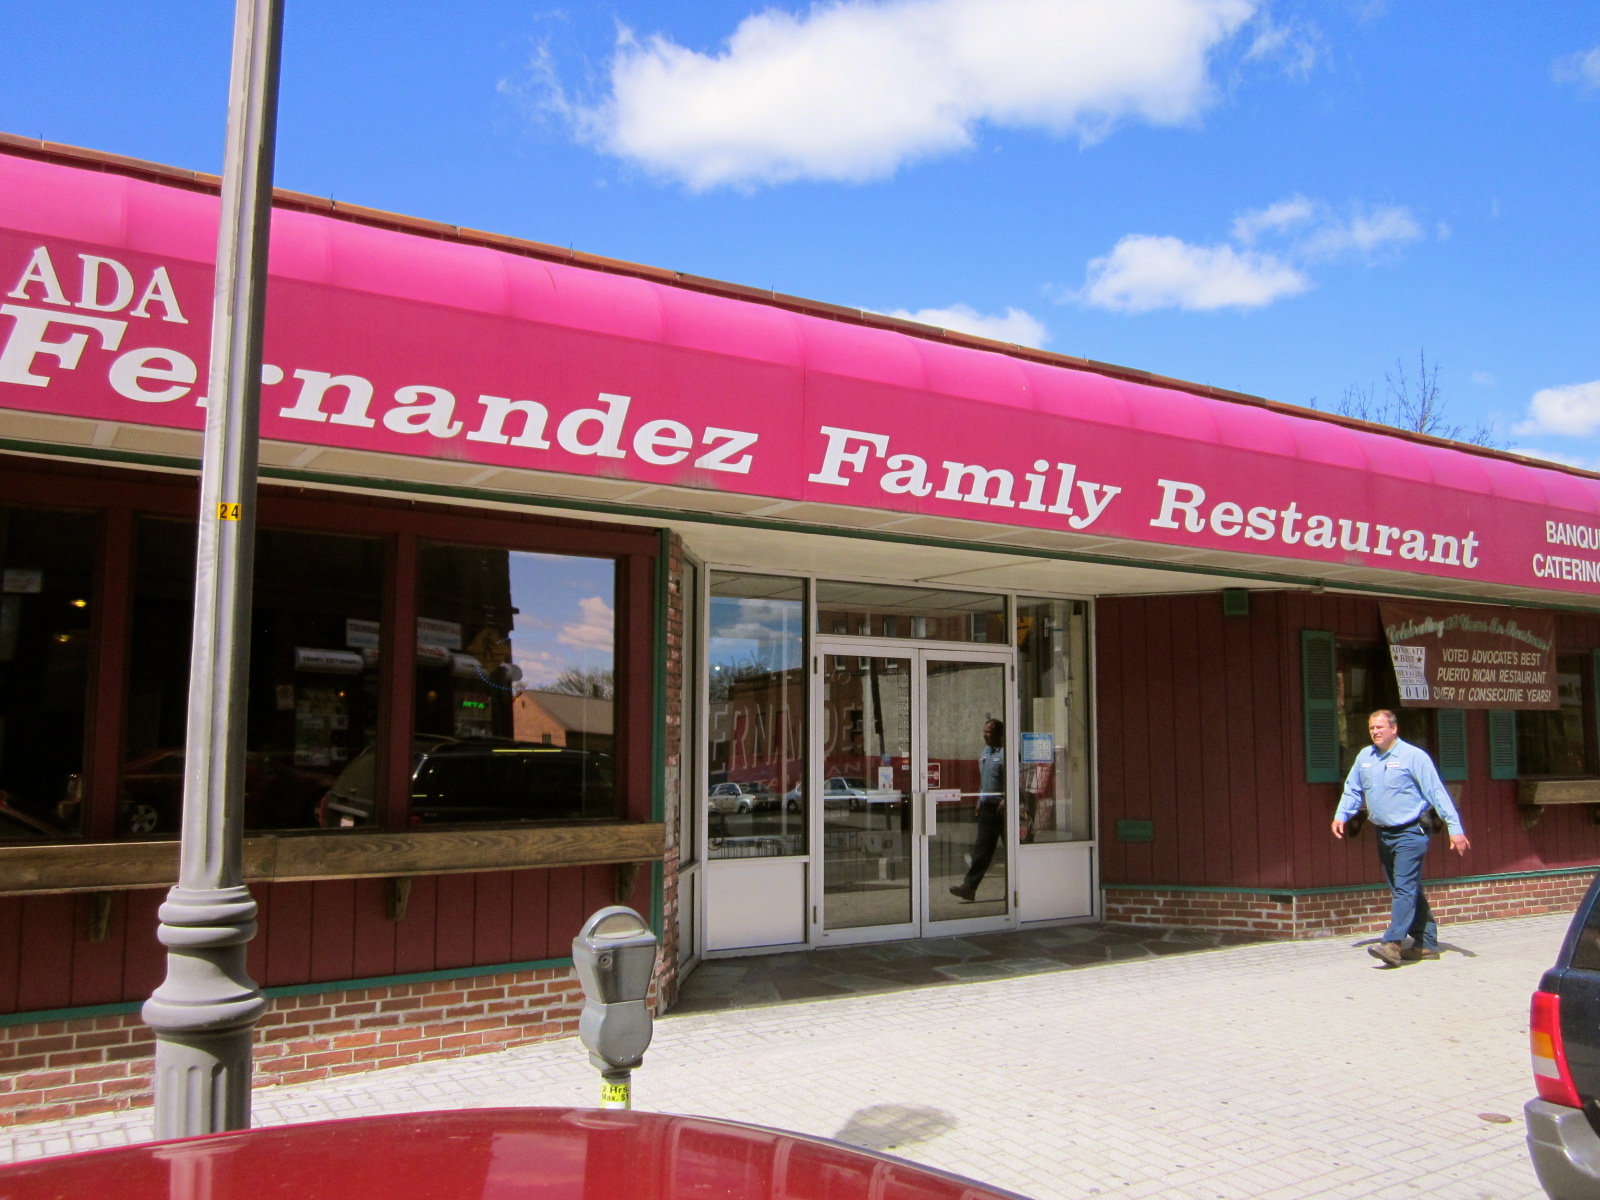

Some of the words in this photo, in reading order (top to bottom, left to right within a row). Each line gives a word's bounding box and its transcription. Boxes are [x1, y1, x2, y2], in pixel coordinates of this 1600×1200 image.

[8, 246, 189, 324] ADA
[0, 303, 759, 474] Fenandez
[808, 425, 1122, 530] Family
[1150, 478, 1480, 569] Restaurant
[220, 503, 239, 519] 24
[1545, 520, 1600, 550] BANQU
[1442, 648, 1469, 663] VOTED
[1471, 649, 1519, 665] ADVOCATE'S
[1520, 652, 1541, 667] BEST
[1436, 667, 1470, 682] PUERTO
[1472, 668, 1496, 683] RICAN
[1498, 669, 1547, 684] RESTAURANT
[1433, 686, 1456, 700] OVER
[1458, 687, 1466, 701] 11
[1468, 687, 1524, 702] CONSECUTIVE
[1526, 689, 1551, 703] YEARS!
